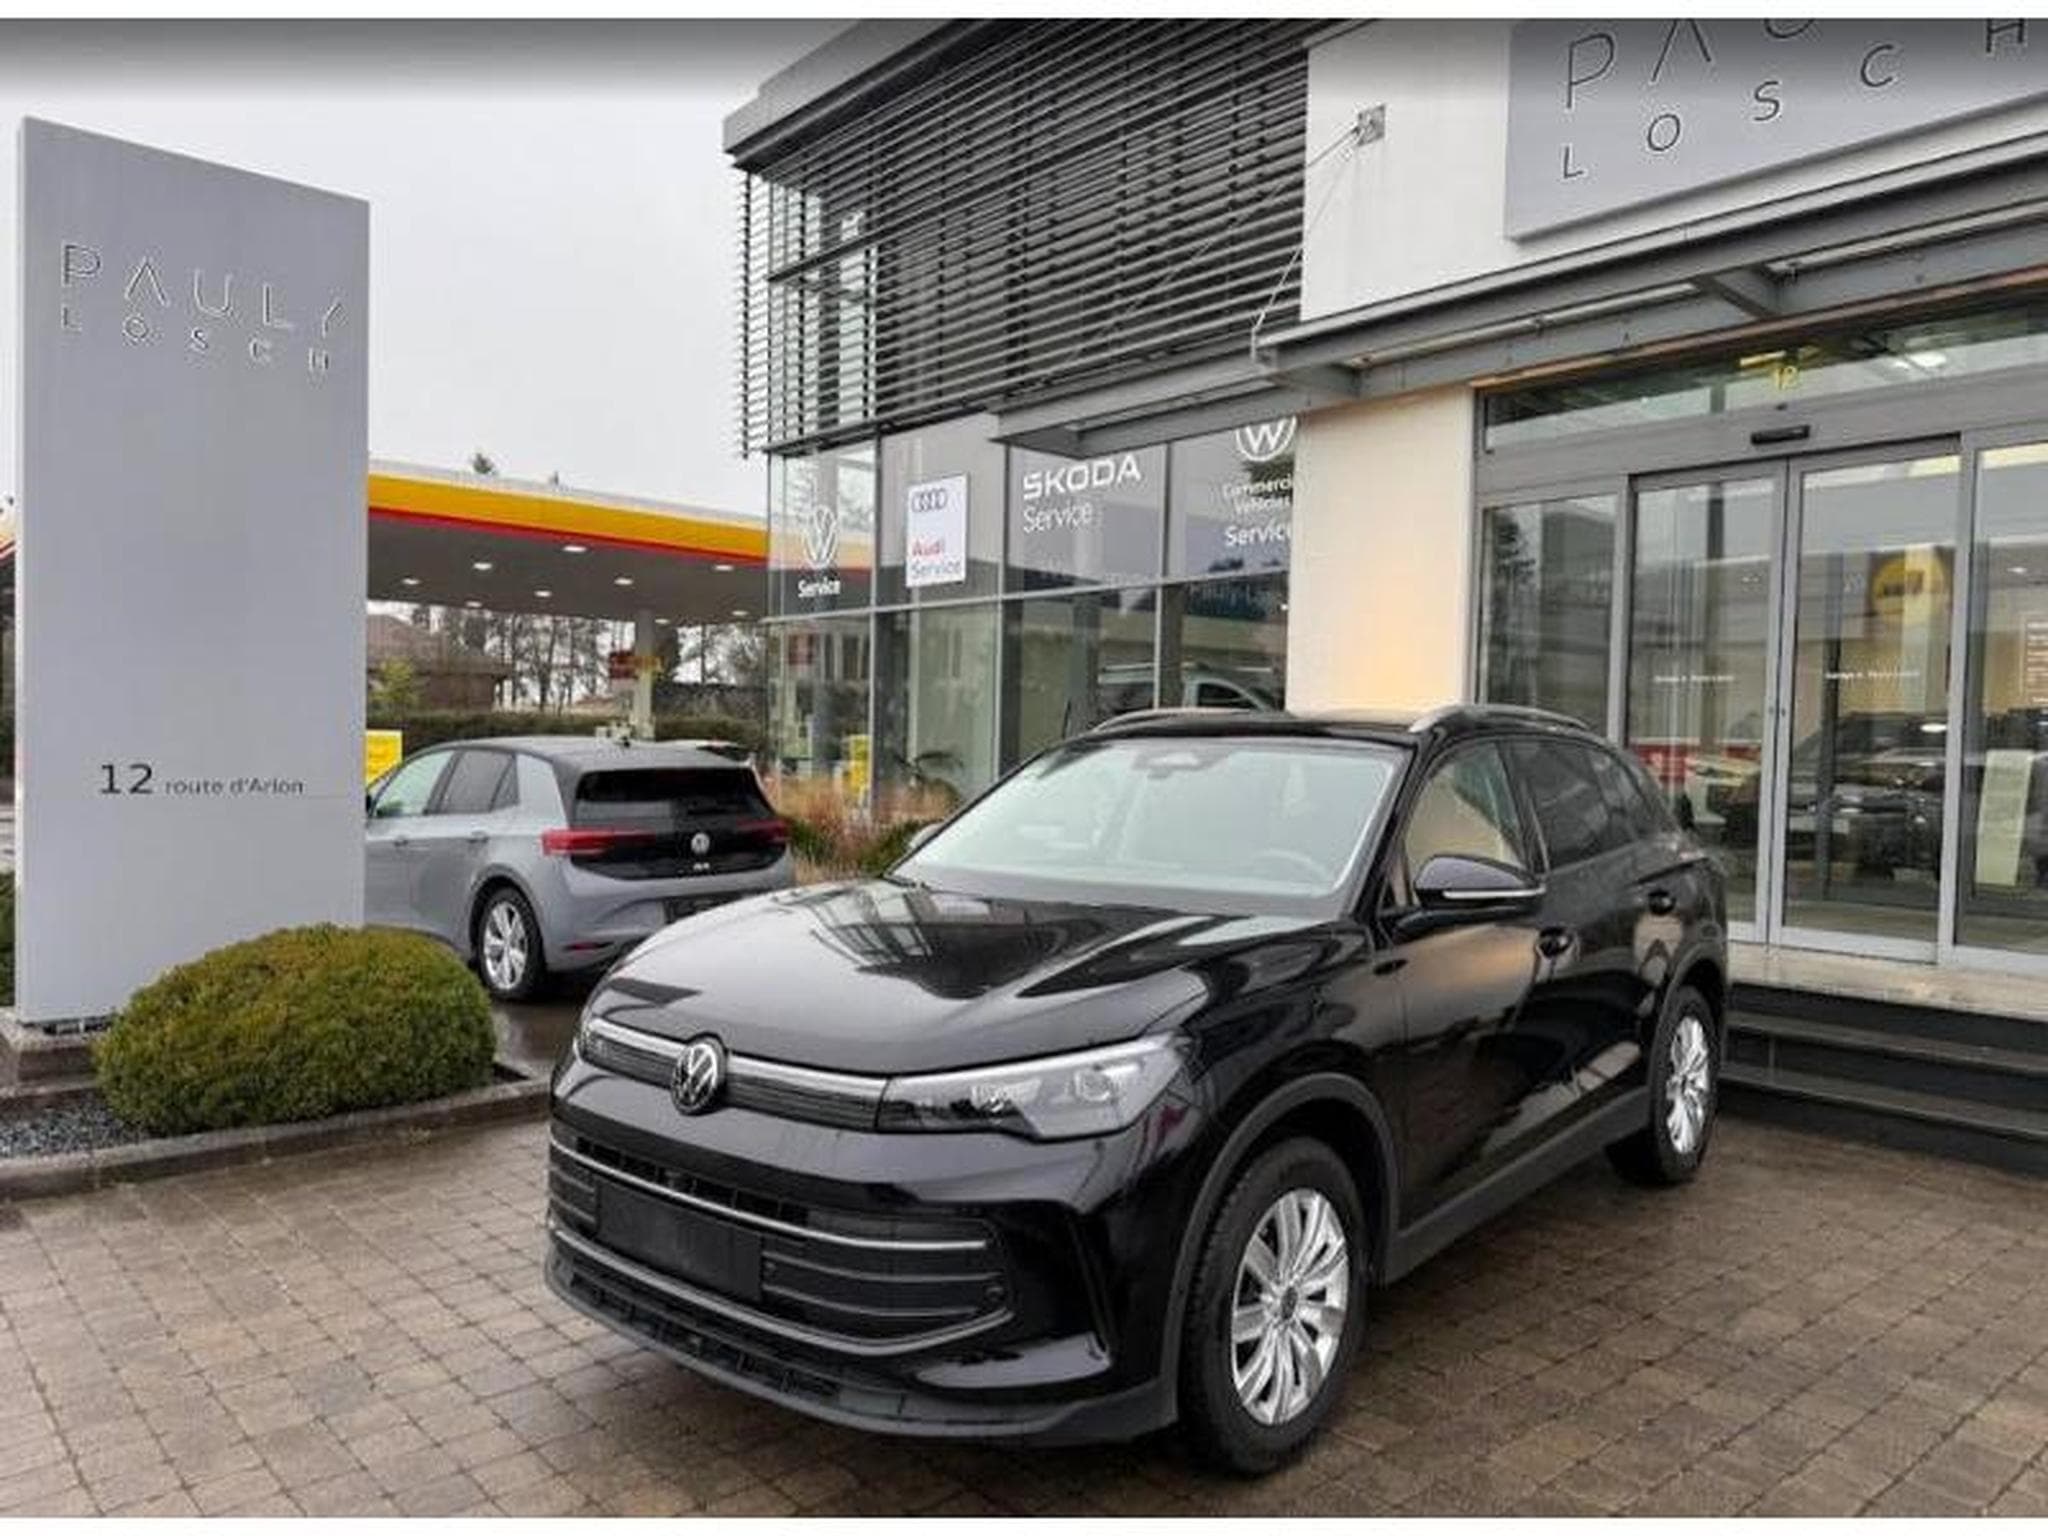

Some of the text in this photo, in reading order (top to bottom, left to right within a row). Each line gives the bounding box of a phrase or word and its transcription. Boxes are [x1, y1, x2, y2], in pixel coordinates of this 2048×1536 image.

[61, 242, 347, 339] PAULY
[61, 303, 330, 371] LOSCH
[1222, 473, 1292, 498] Commerci
[1022, 502, 1093, 534] Service
[911, 537, 945, 557] Audi
[911, 560, 961, 579] Service
[797, 577, 841, 599] Service
[100, 763, 304, 796] 12 route d'Arlon
